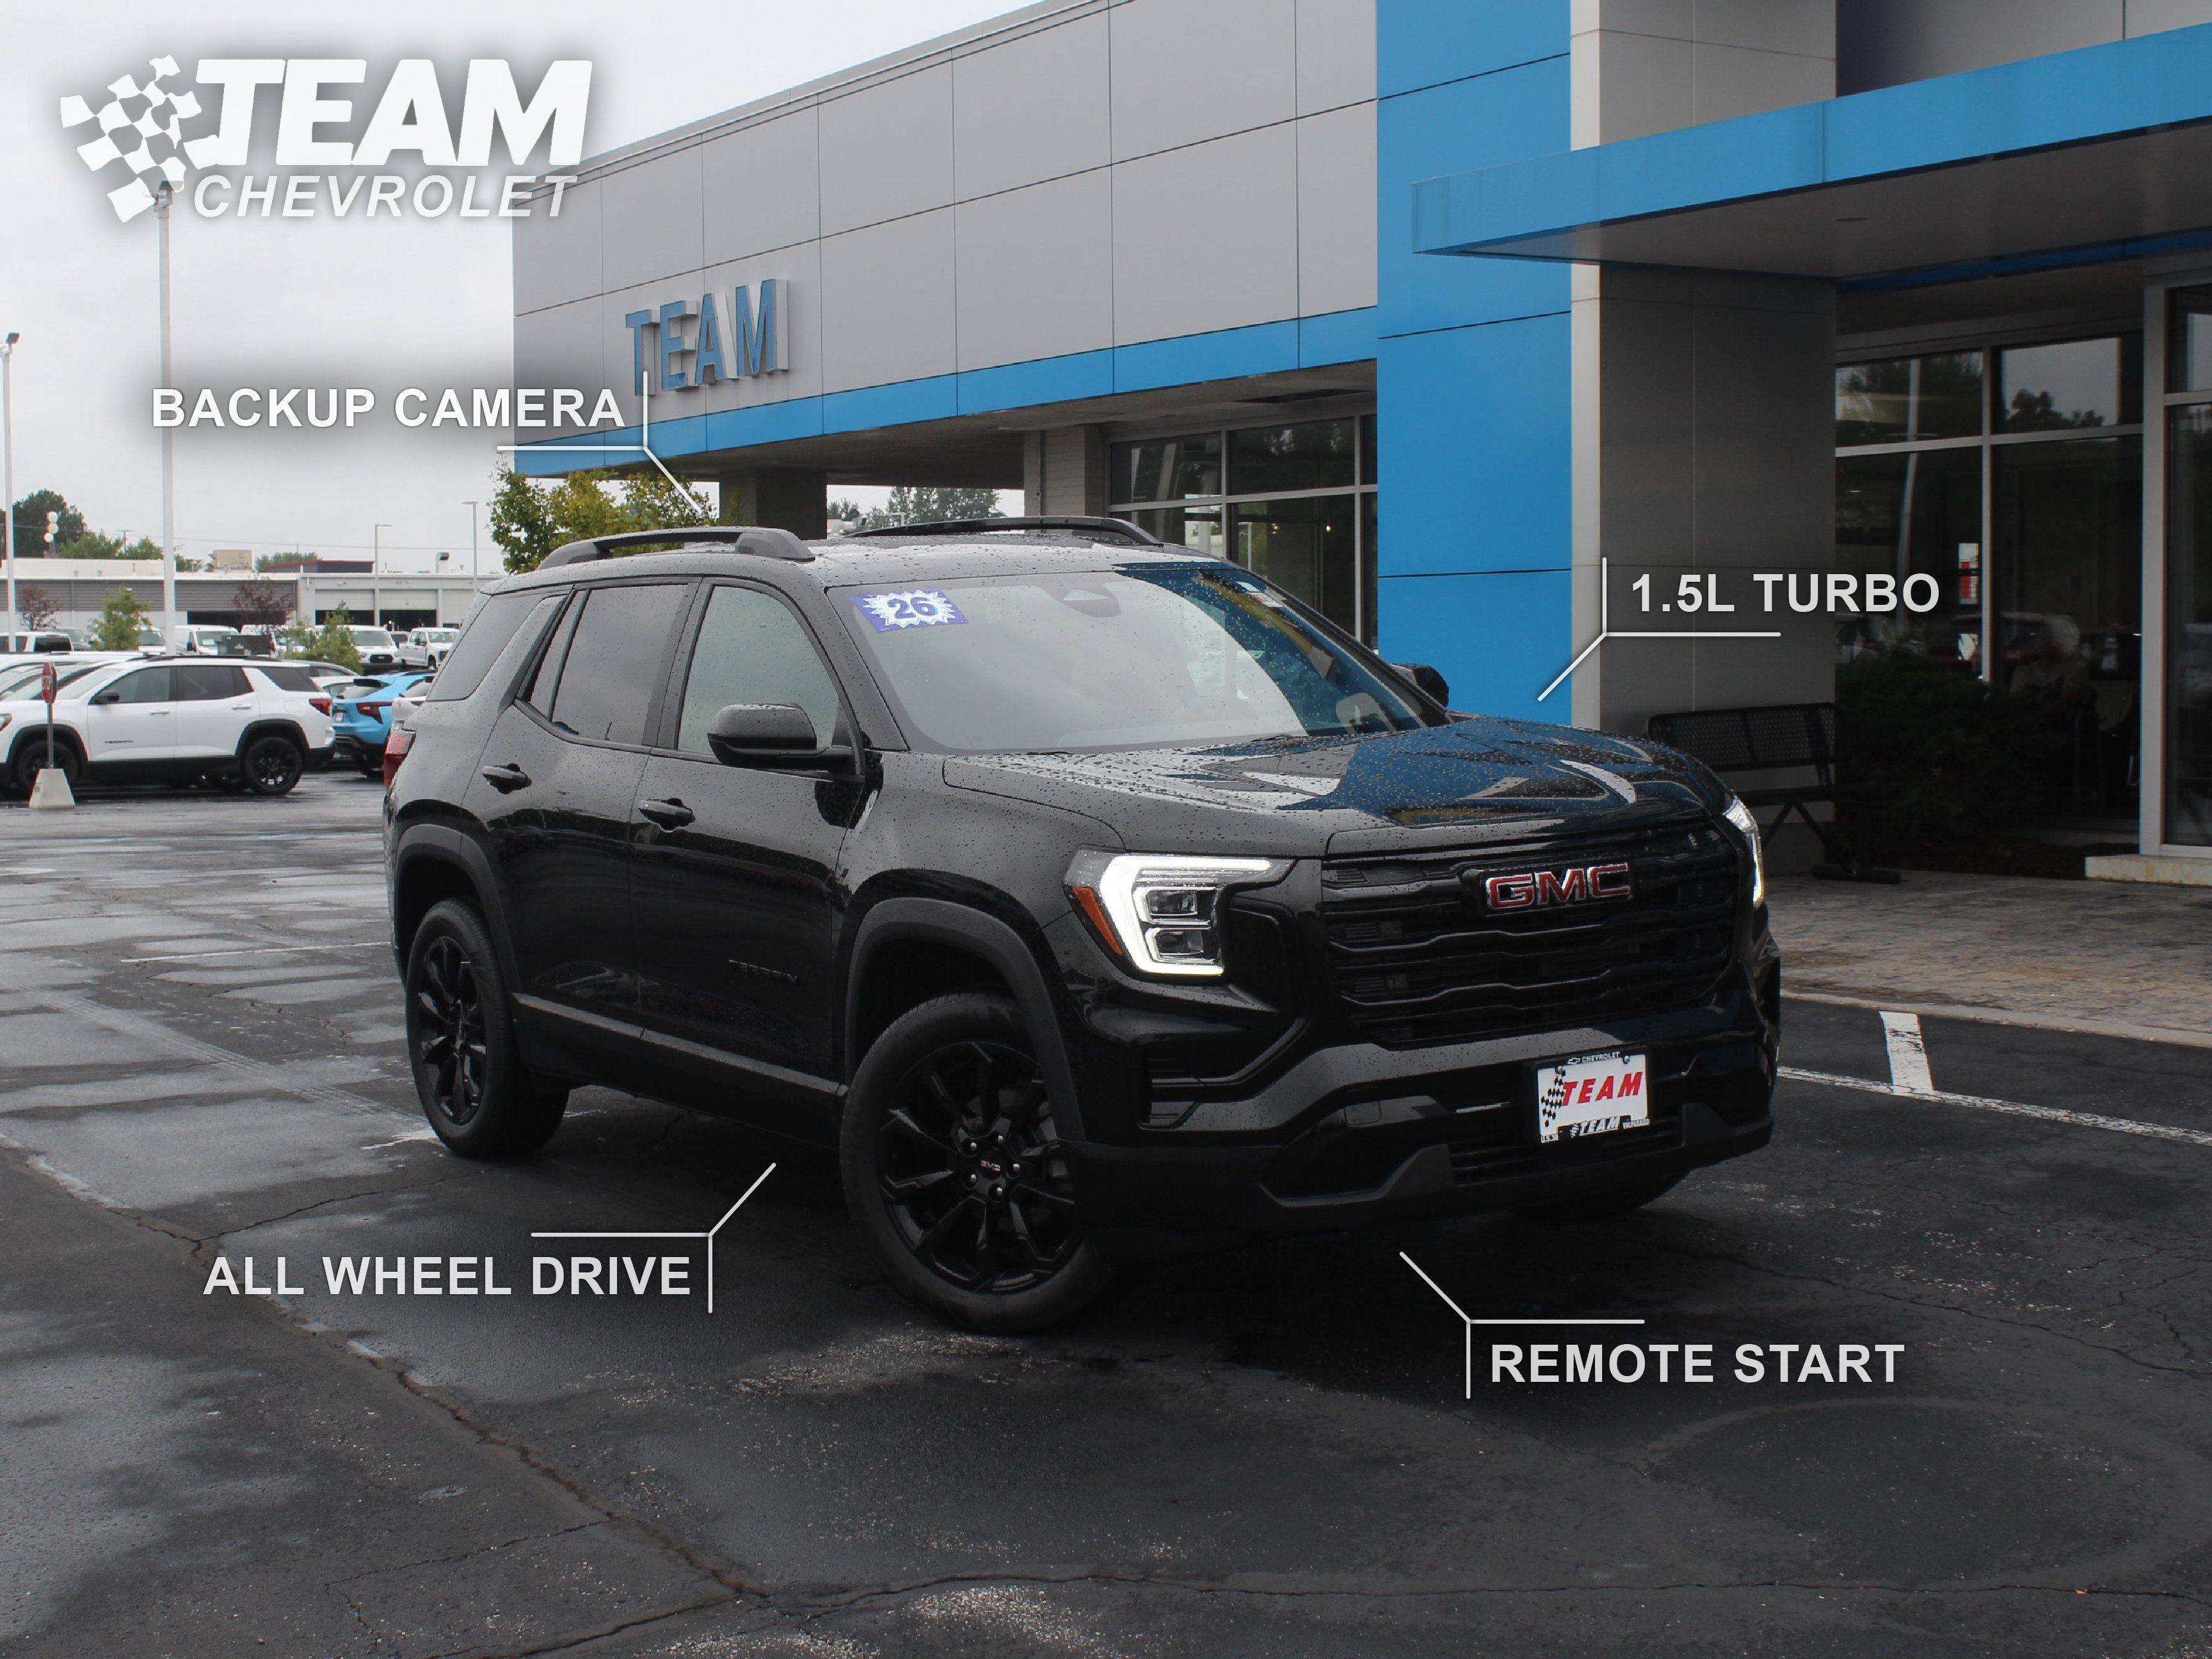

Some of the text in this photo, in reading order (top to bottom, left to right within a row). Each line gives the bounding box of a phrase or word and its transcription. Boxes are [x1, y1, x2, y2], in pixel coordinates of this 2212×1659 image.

[625, 278, 788, 397] TEAM
[887, 597, 938, 620] 26
[1486, 863, 1631, 910] GMC
[1582, 1051, 1621, 1063] CHEVROLET
[1562, 1071, 1644, 1107] TEAM
[1579, 1116, 1621, 1135] TEAM
